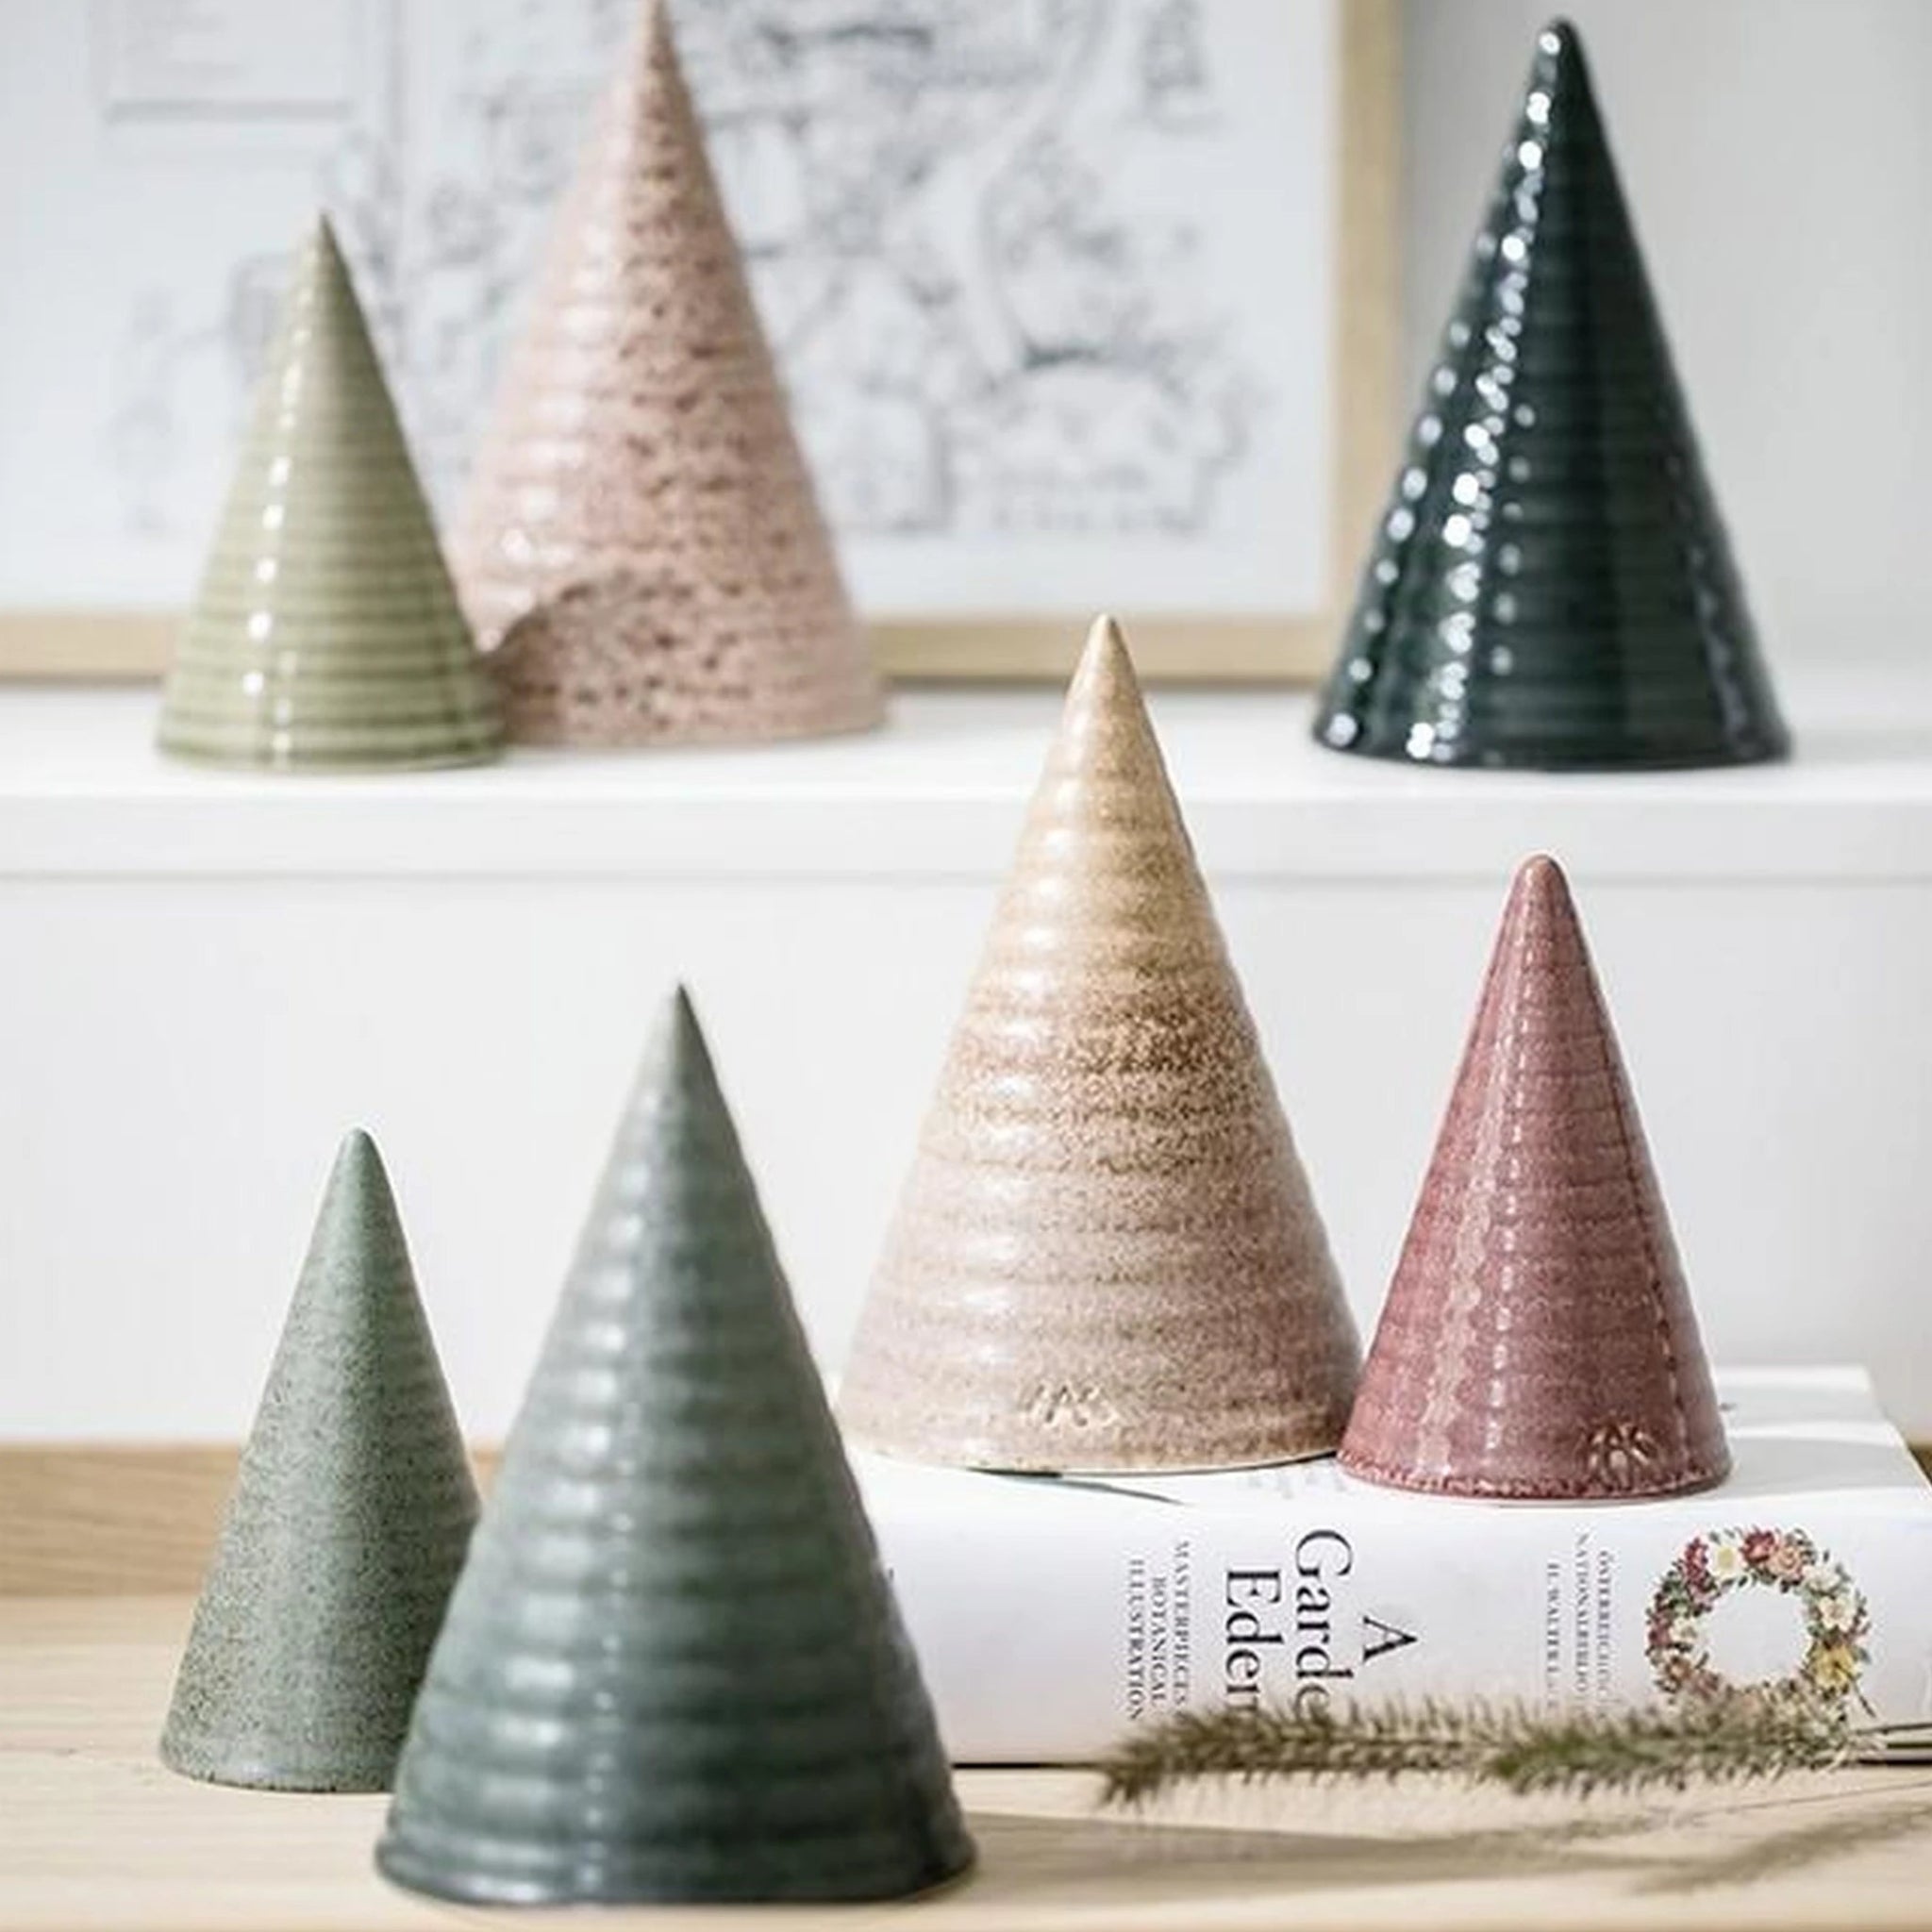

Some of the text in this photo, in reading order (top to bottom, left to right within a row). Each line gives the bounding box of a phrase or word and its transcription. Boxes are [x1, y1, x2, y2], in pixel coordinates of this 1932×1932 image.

[1127, 1558, 1144, 1721] ILLUSTRATION
[1151, 1576, 1168, 1707] BOTANICAL
[1174, 1540, 1191, 1706] MASTERPIECES
[1295, 1528, 1354, 1720] Garde
[1362, 1615, 1418, 1664] A
